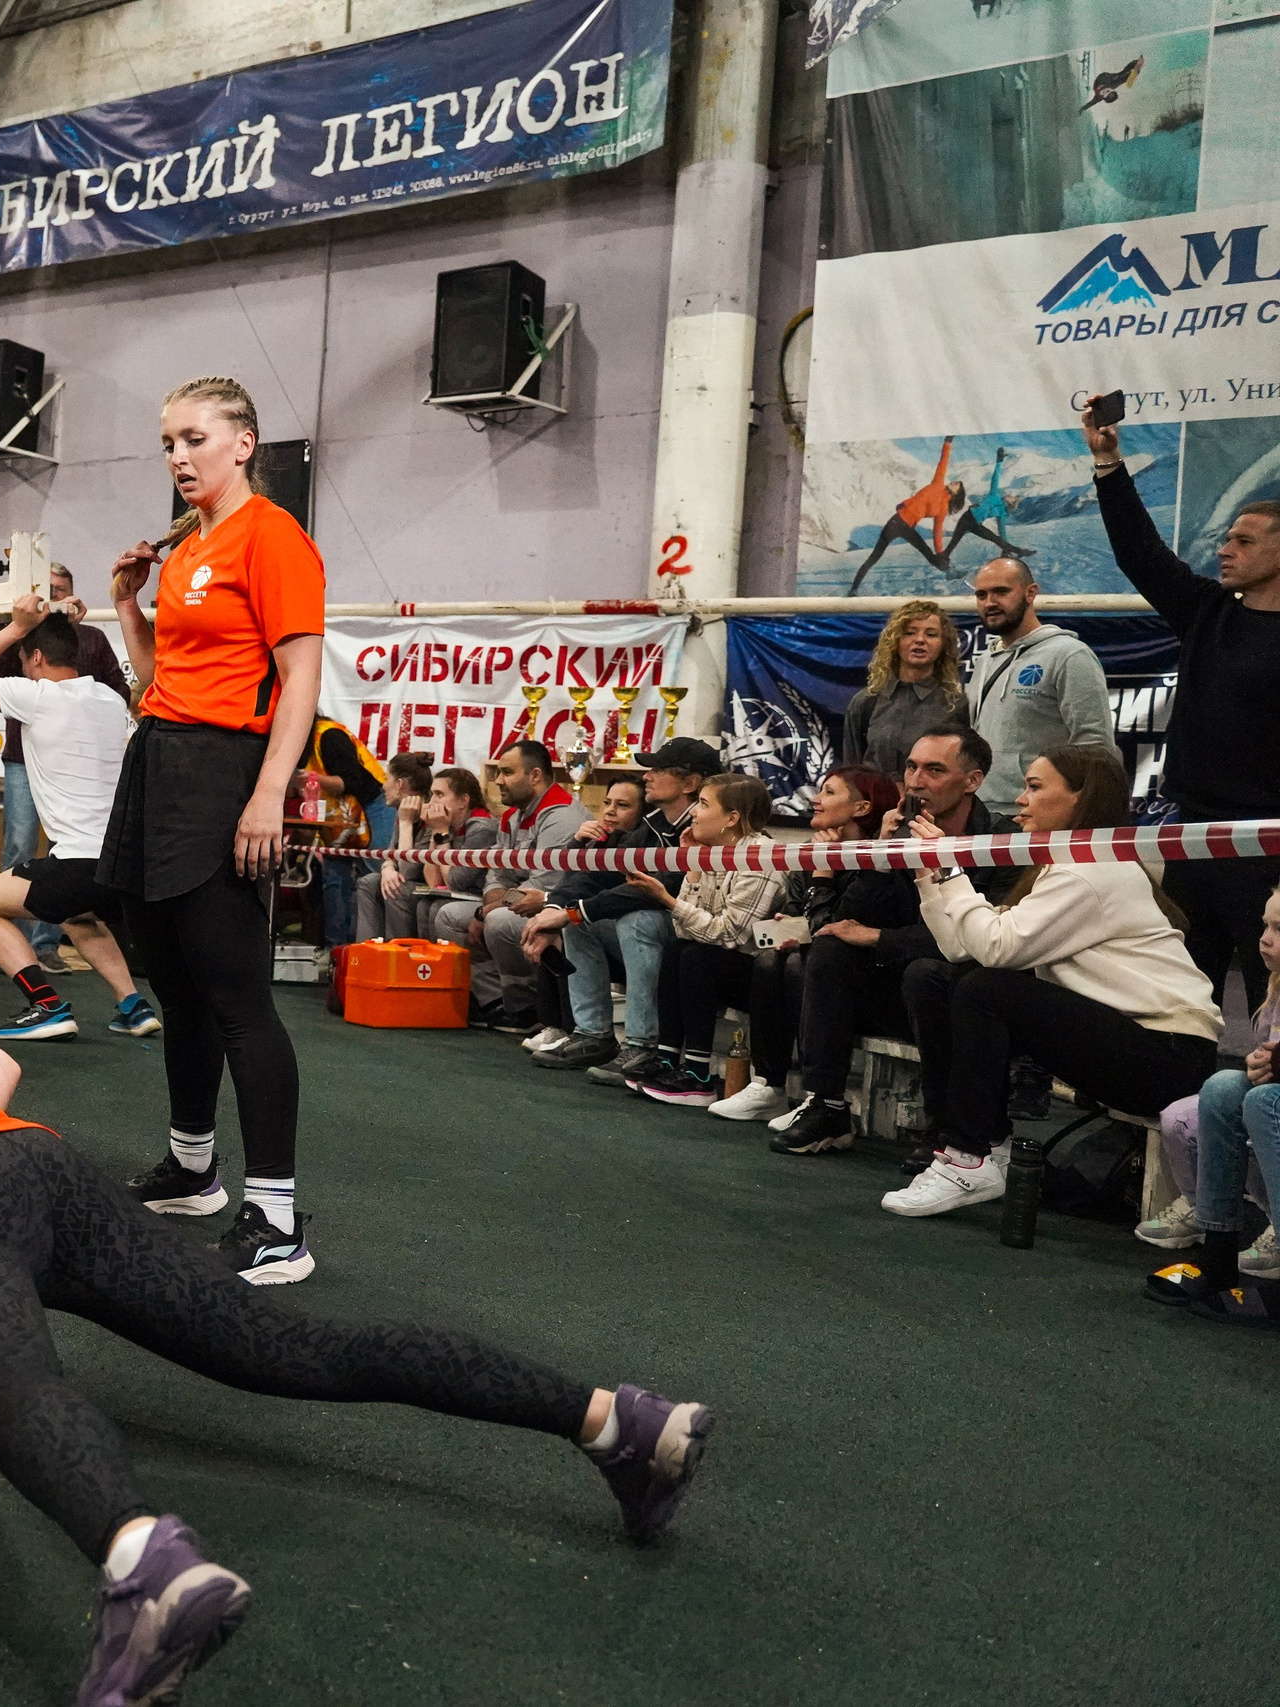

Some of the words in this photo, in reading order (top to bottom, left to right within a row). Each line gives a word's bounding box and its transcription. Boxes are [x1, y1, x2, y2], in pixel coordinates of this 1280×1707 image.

[310, 52, 629, 177] ЛЕГИОН
[1035, 311, 1168, 346] ТОВАРЫ
[1172, 302, 1248, 339] ДЛЯ
[1178, 388, 1216, 412] ул.
[657, 535, 694, 577] 2
[359, 702, 658, 765] ЛЕГИОН
[957, 1176, 971, 1188] FILA
